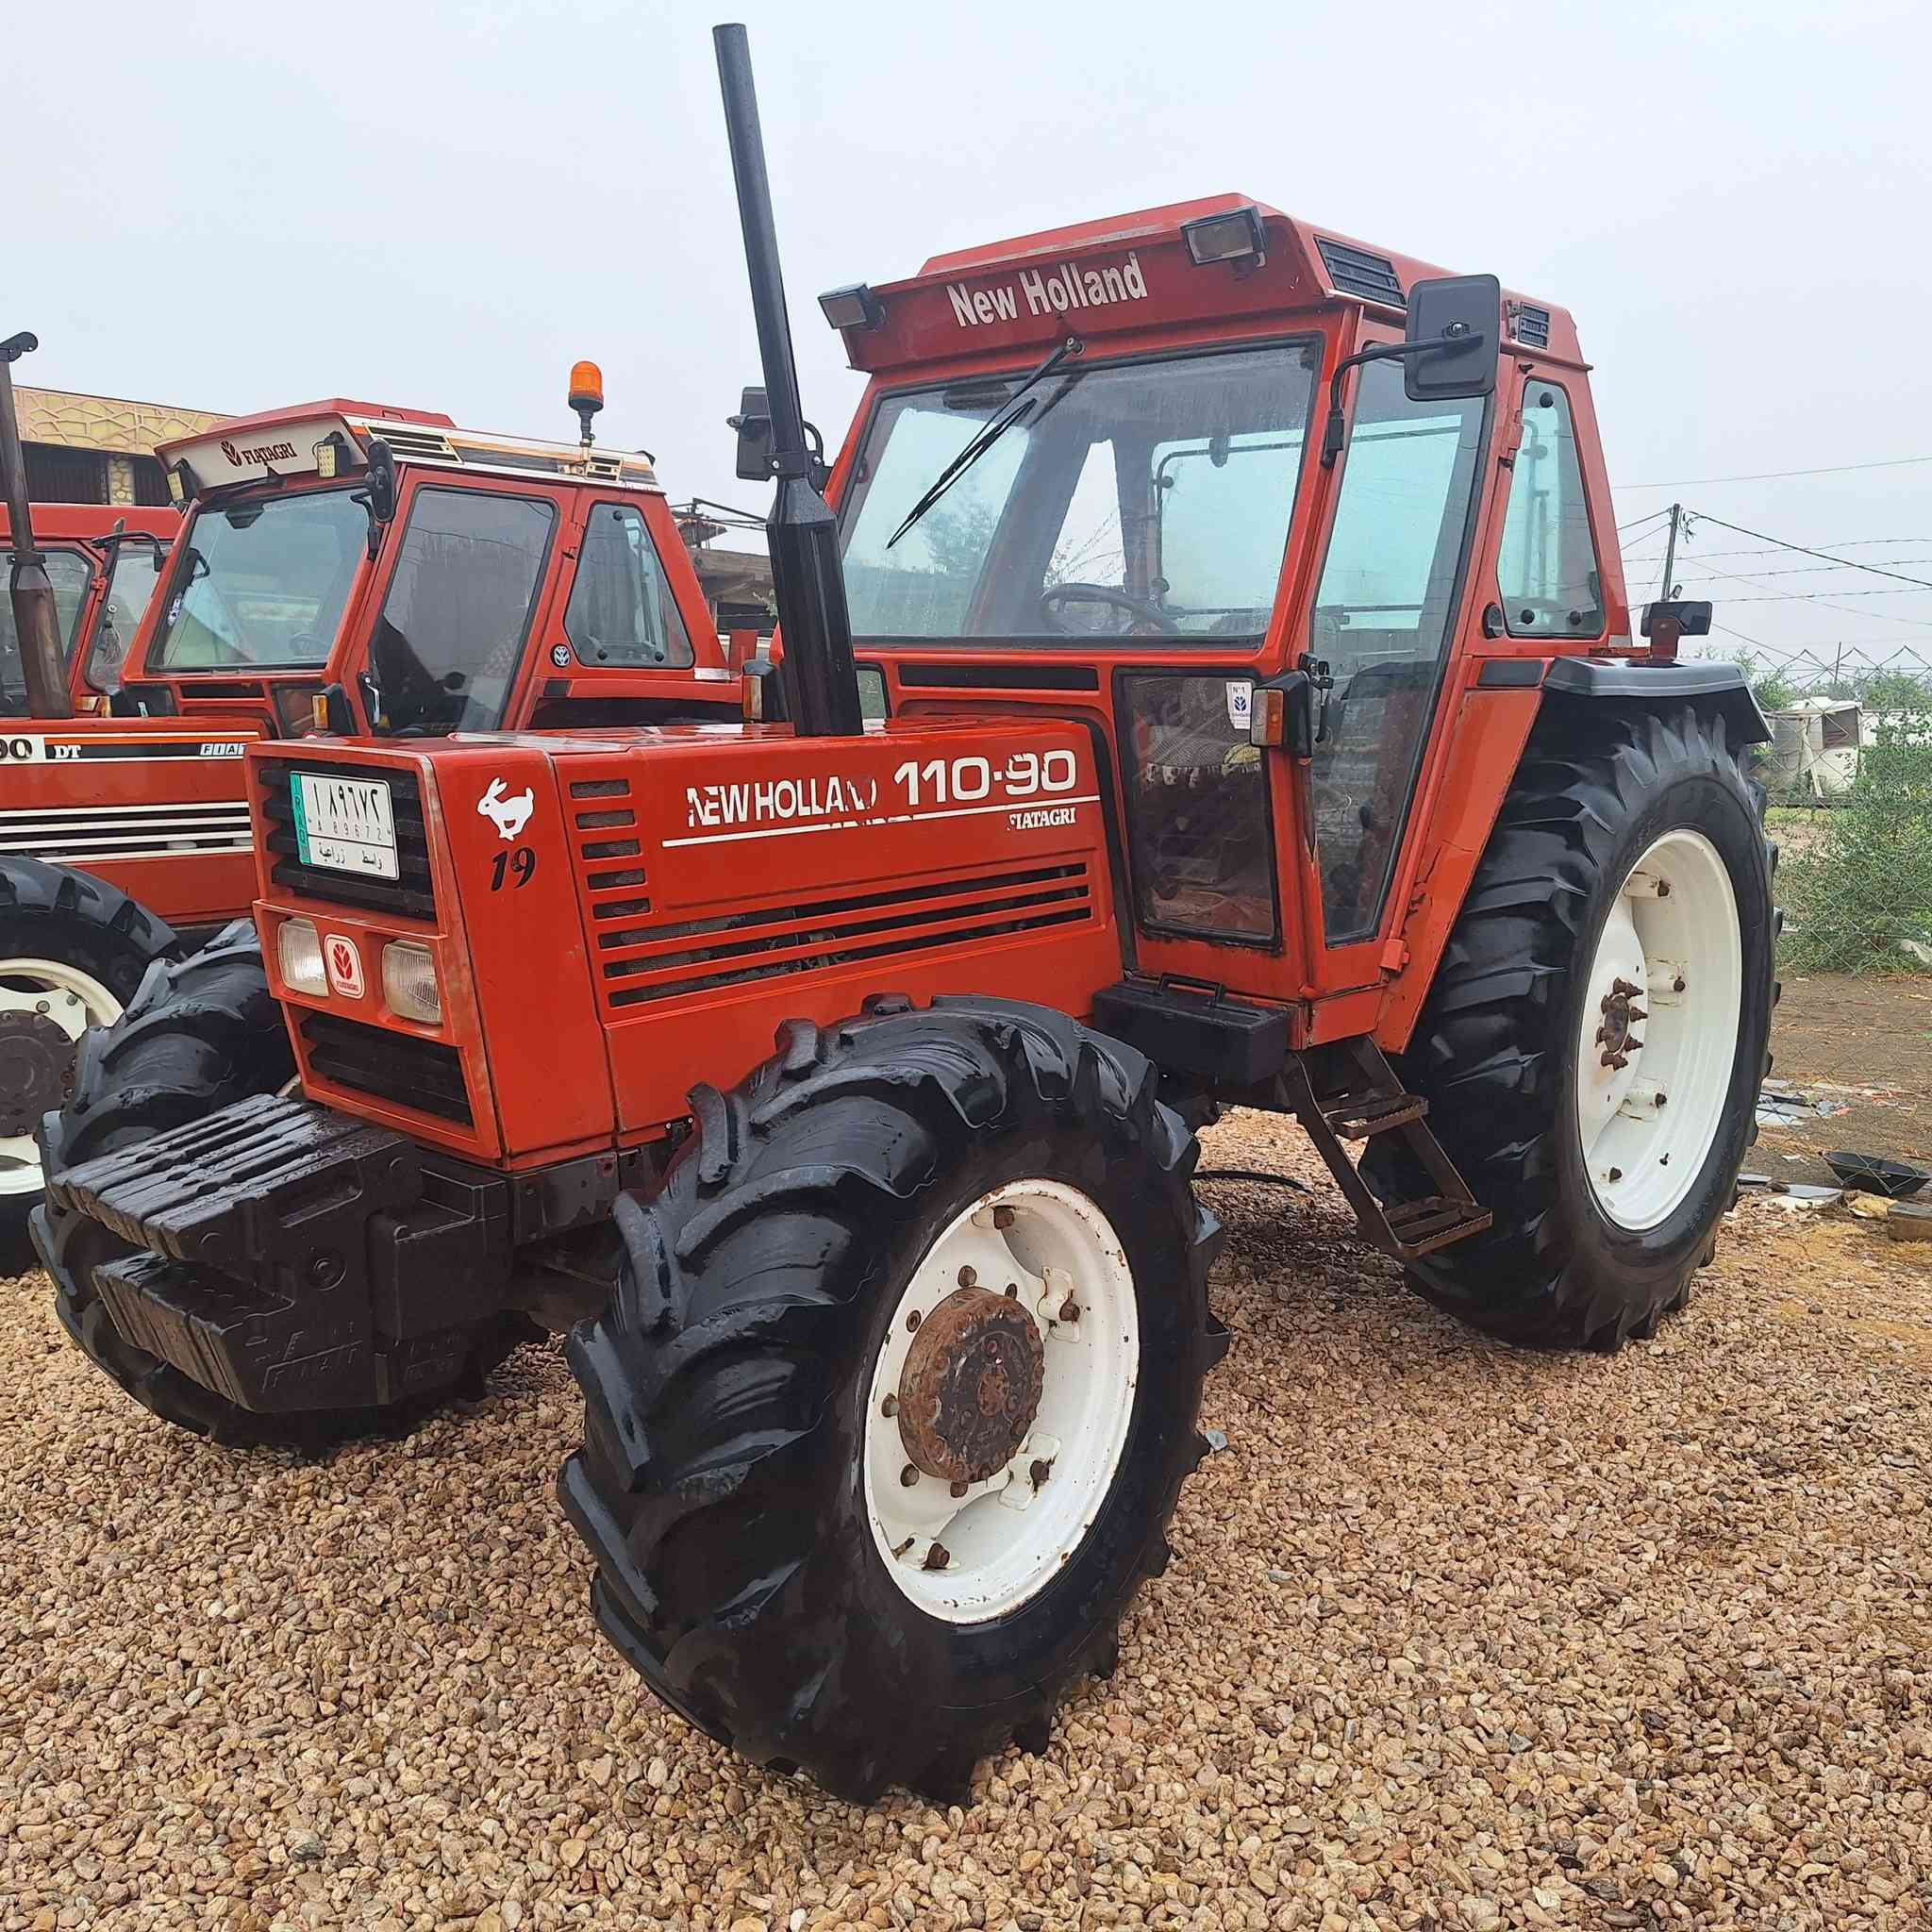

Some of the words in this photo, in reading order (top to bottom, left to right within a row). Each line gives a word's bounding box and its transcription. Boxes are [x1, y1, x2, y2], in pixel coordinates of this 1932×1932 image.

[946, 282, 1018, 327] New
[1019, 251, 1148, 316] Holland
[241, 441, 298, 465] FIATAGRI
[54, 744, 81, 758] DT
[201, 743, 244, 755] FIA
[686, 783, 749, 827] NEW
[491, 846, 536, 891] 19
